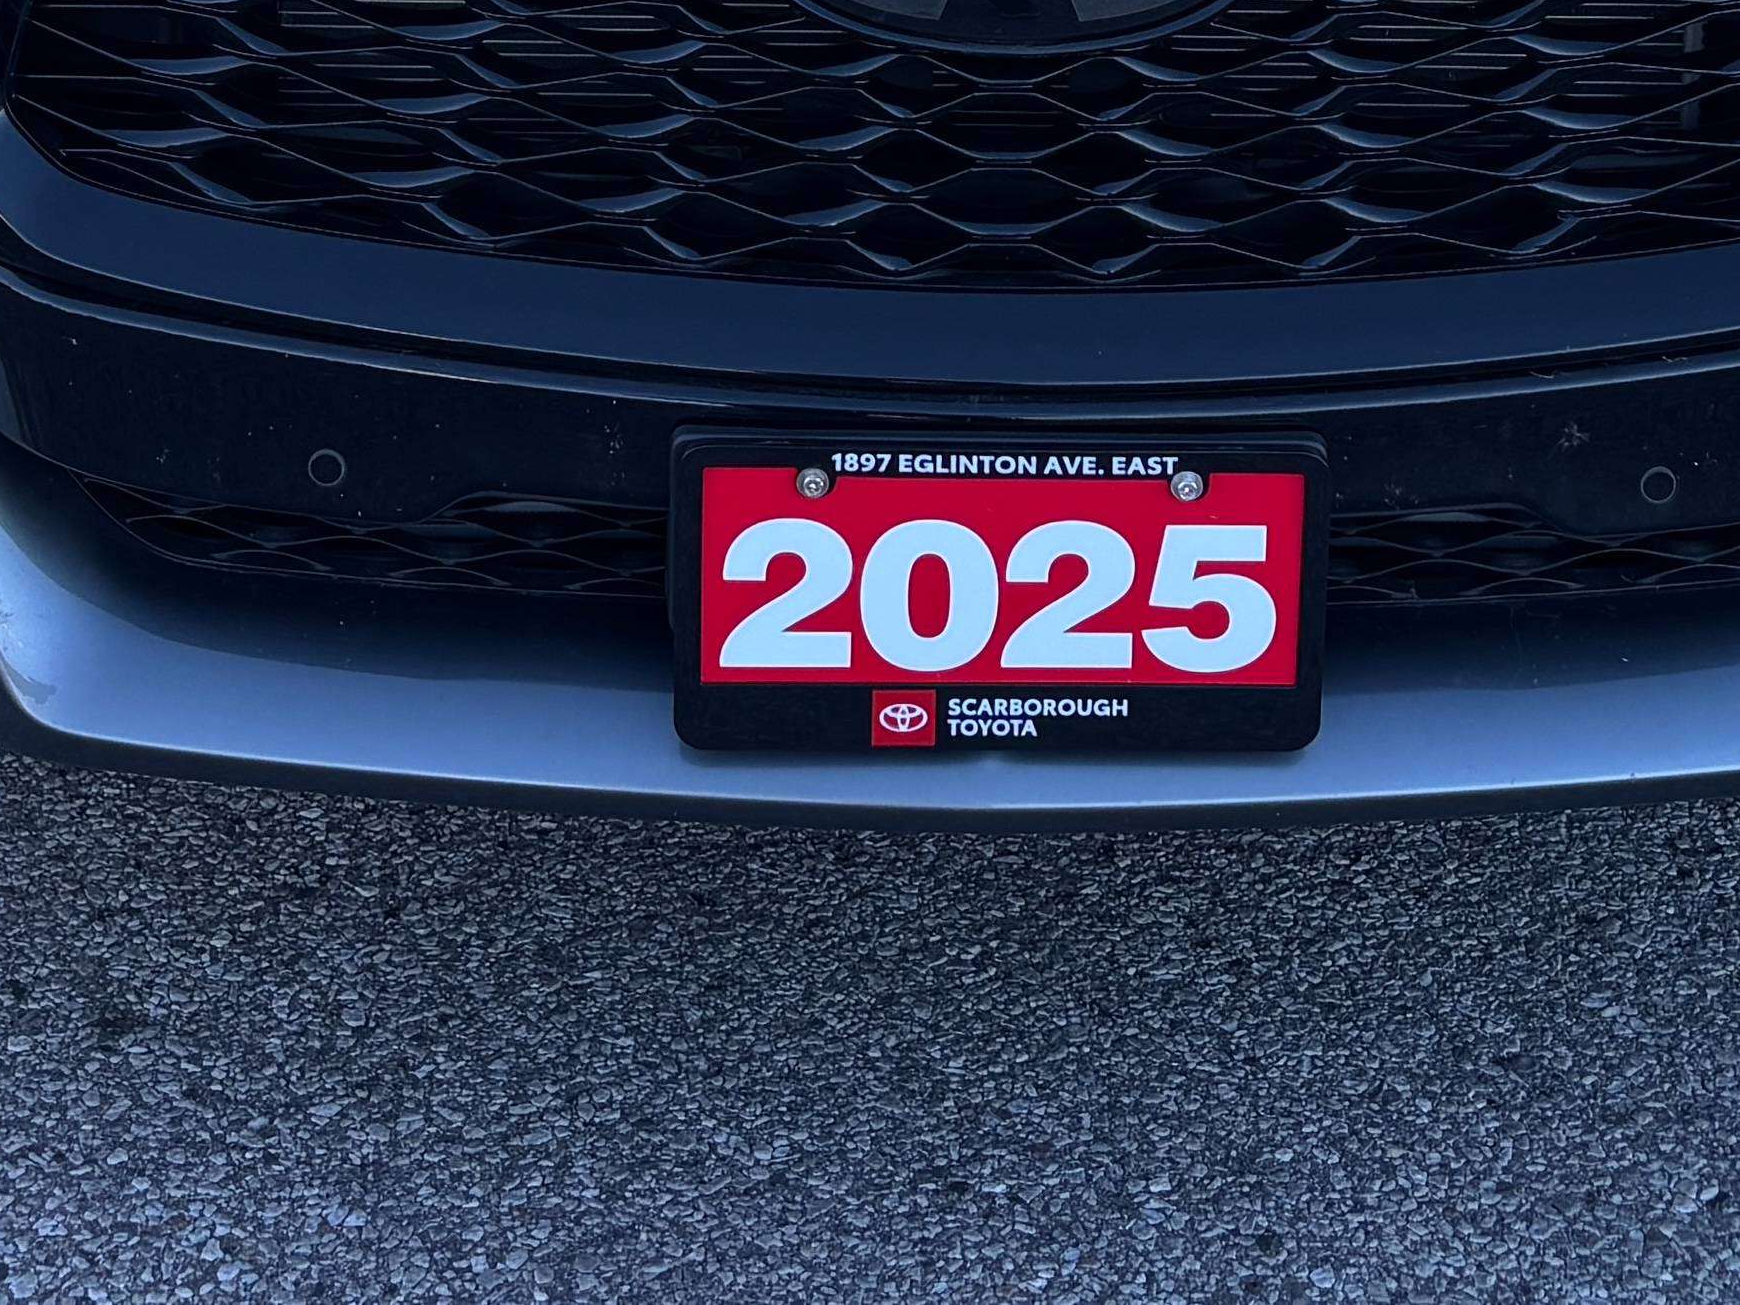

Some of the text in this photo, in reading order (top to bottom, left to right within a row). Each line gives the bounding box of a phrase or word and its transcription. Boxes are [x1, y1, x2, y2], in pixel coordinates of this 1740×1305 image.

[831, 452, 1179, 476] 1897 EGLINTON AVE. EAST
[718, 516, 1278, 674] 2025
[947, 698, 1129, 717] SCARBOROUGH
[947, 718, 1038, 737] TOYOTA
